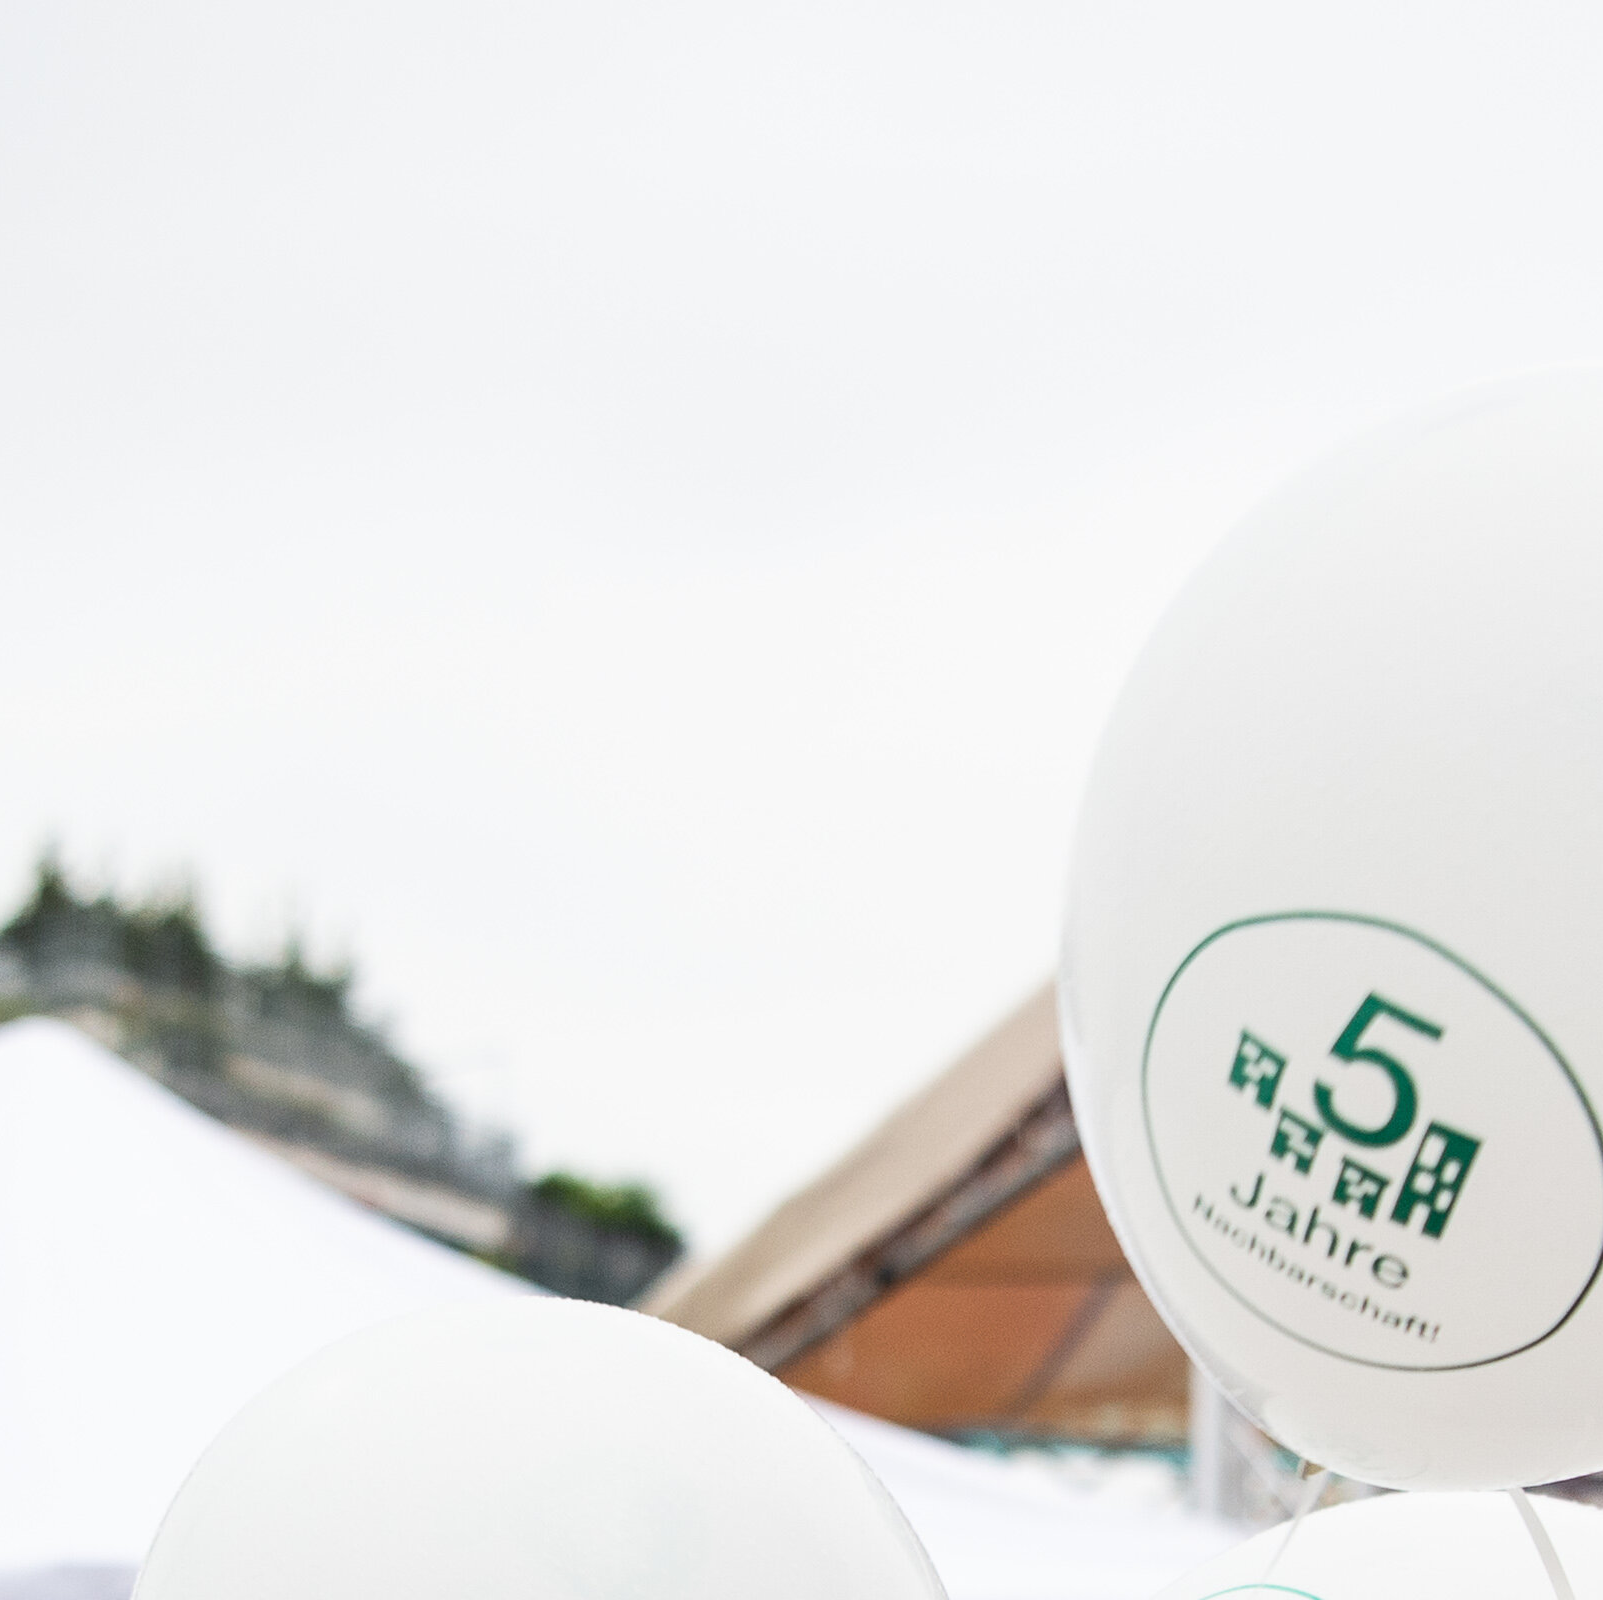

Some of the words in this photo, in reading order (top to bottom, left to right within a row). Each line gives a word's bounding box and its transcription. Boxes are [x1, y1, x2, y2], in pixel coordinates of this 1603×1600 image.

[1313, 992, 1444, 1148] 5
[1192, 1193, 1440, 1343] Nachbarschaft!
[1230, 1173, 1409, 1289] Jahre
